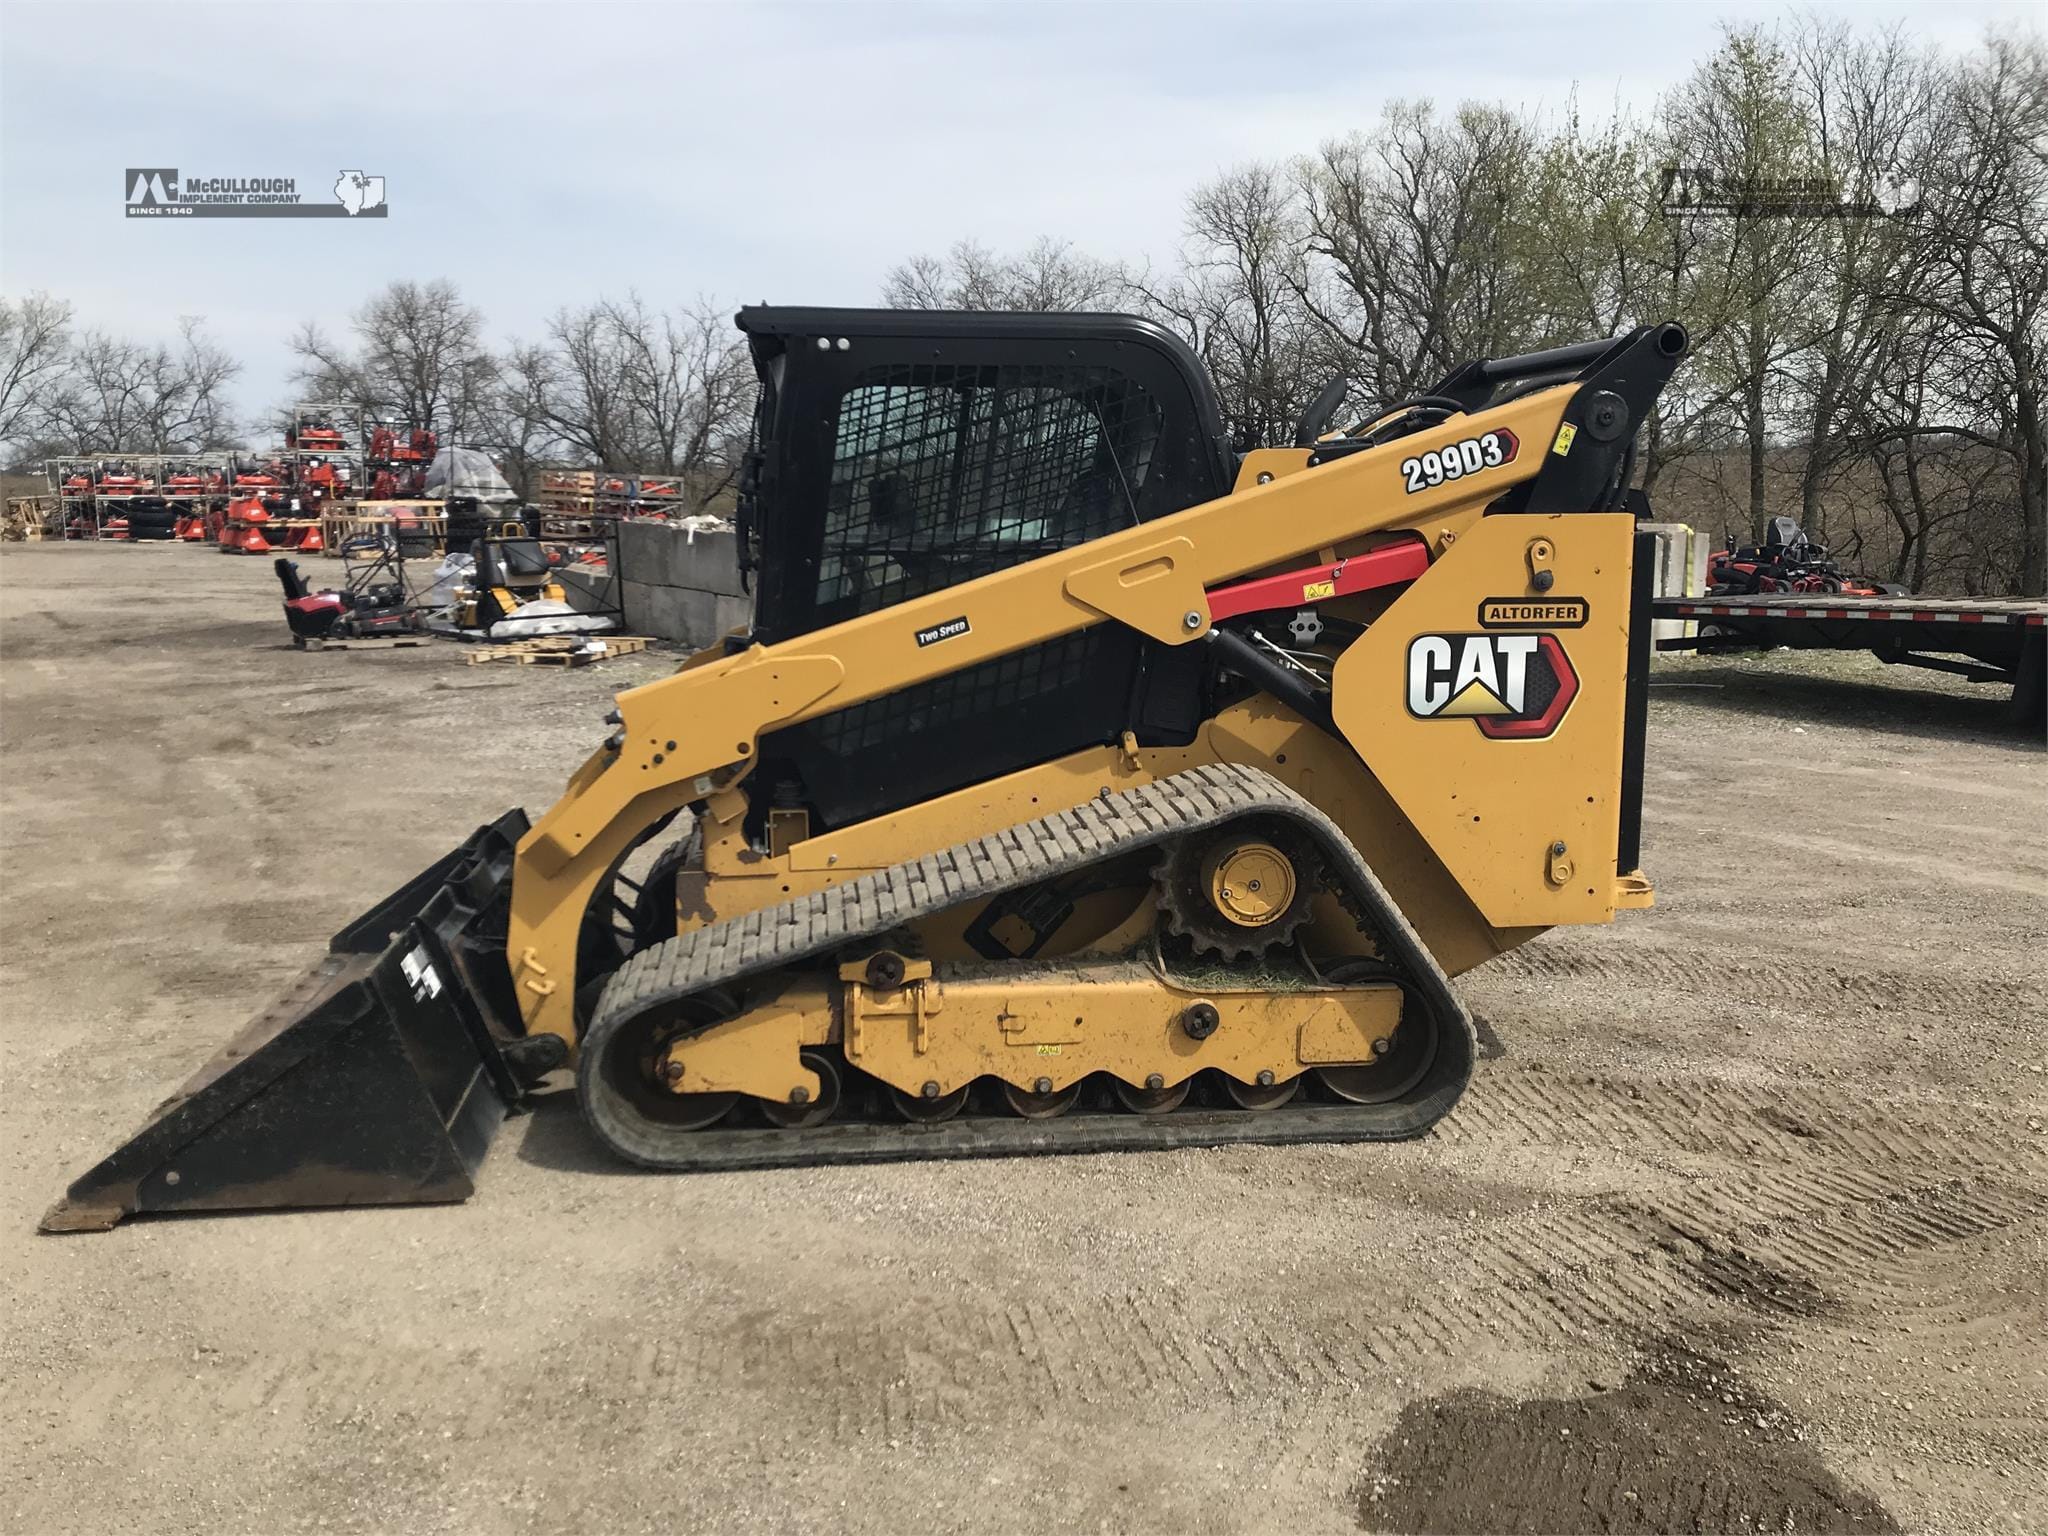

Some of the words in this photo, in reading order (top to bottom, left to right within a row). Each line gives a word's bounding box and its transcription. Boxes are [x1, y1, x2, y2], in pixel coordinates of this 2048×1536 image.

[1402, 433, 1503, 493] 299D3
[1490, 607, 1578, 620] ALTORFER
[1410, 636, 1538, 716] CAT
